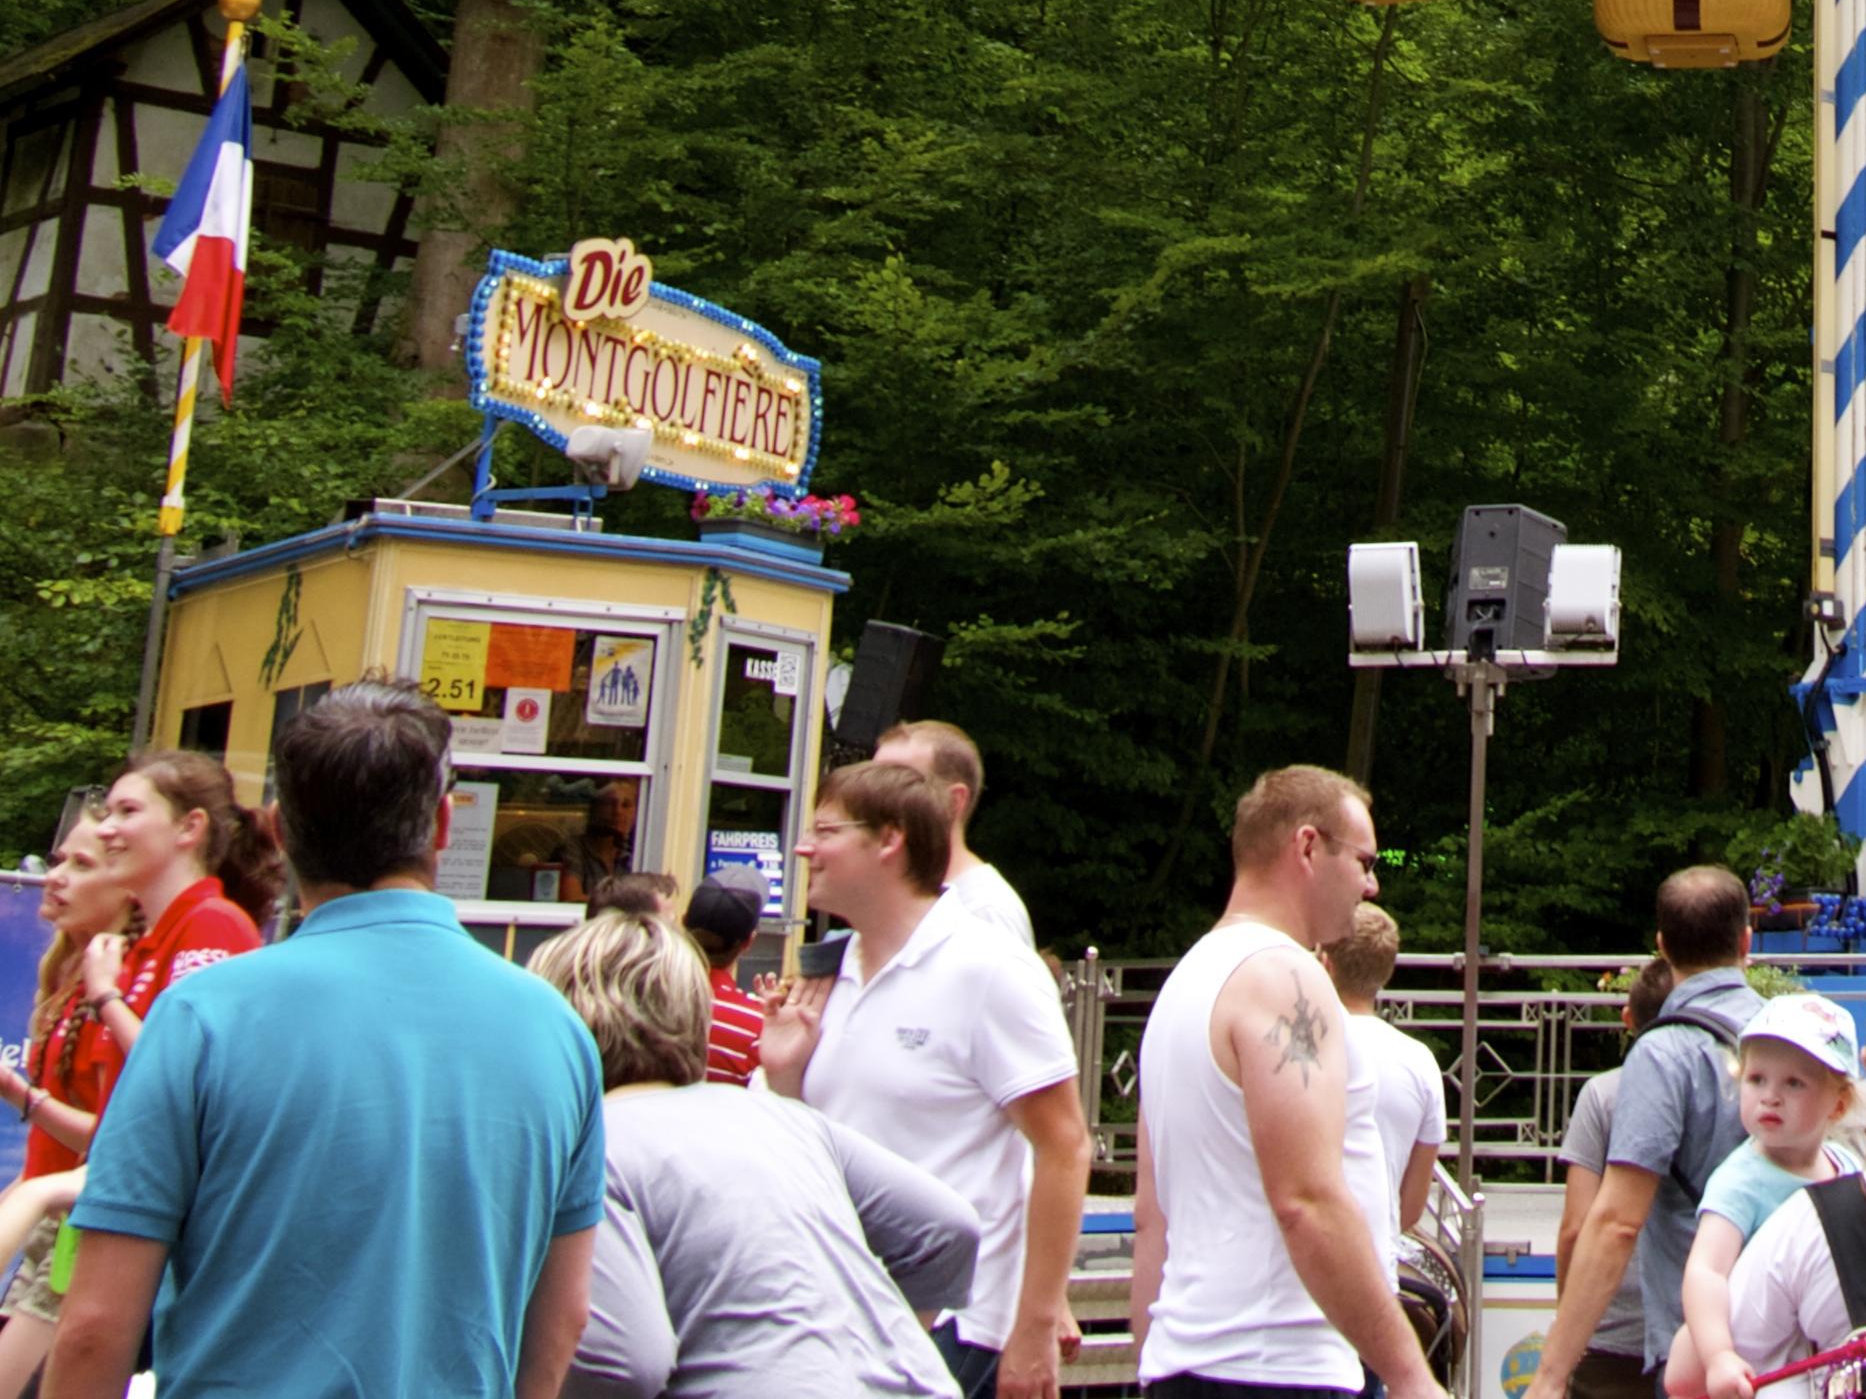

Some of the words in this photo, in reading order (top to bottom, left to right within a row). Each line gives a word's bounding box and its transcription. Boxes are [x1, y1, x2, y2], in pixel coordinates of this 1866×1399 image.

[576, 249, 645, 311] Die
[515, 297, 793, 458] MONTGOLFIÈRE
[427, 678, 475, 699] 2.51
[711, 830, 779, 849] FAHRPREIS
